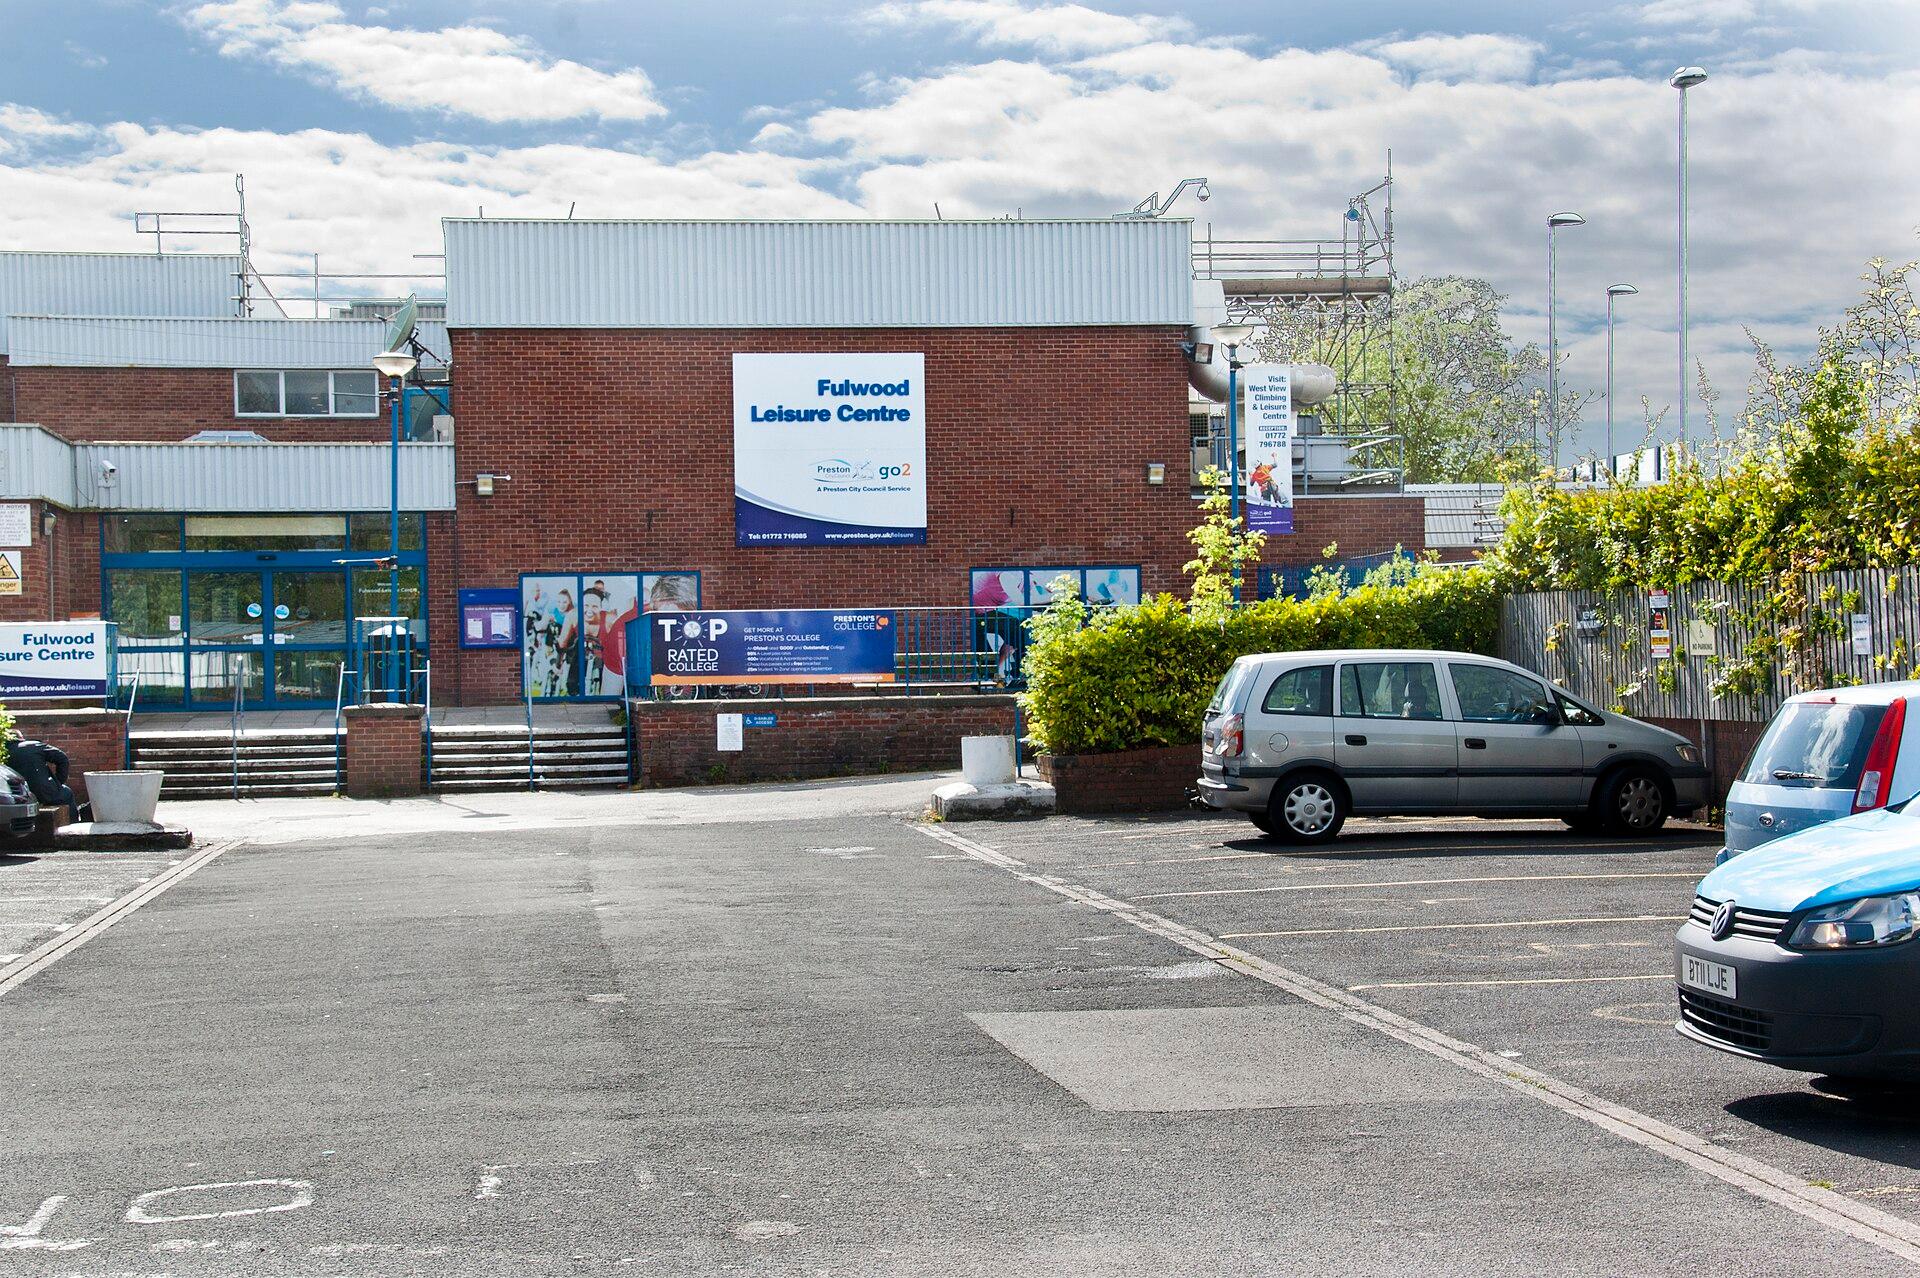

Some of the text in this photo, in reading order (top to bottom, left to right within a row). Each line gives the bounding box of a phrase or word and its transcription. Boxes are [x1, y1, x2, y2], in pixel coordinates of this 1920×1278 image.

[818, 379, 910, 397] Fulwood
[1254, 394, 1287, 402] Climbing
[751, 404, 911, 423] Leisure Centre
[817, 463, 911, 480] Preston go2
[23, 633, 94, 645] Fulwood
[38, 648, 94, 660] Centre
[668, 649, 718, 661] RATED
[668, 662, 718, 672] COLLEGE
